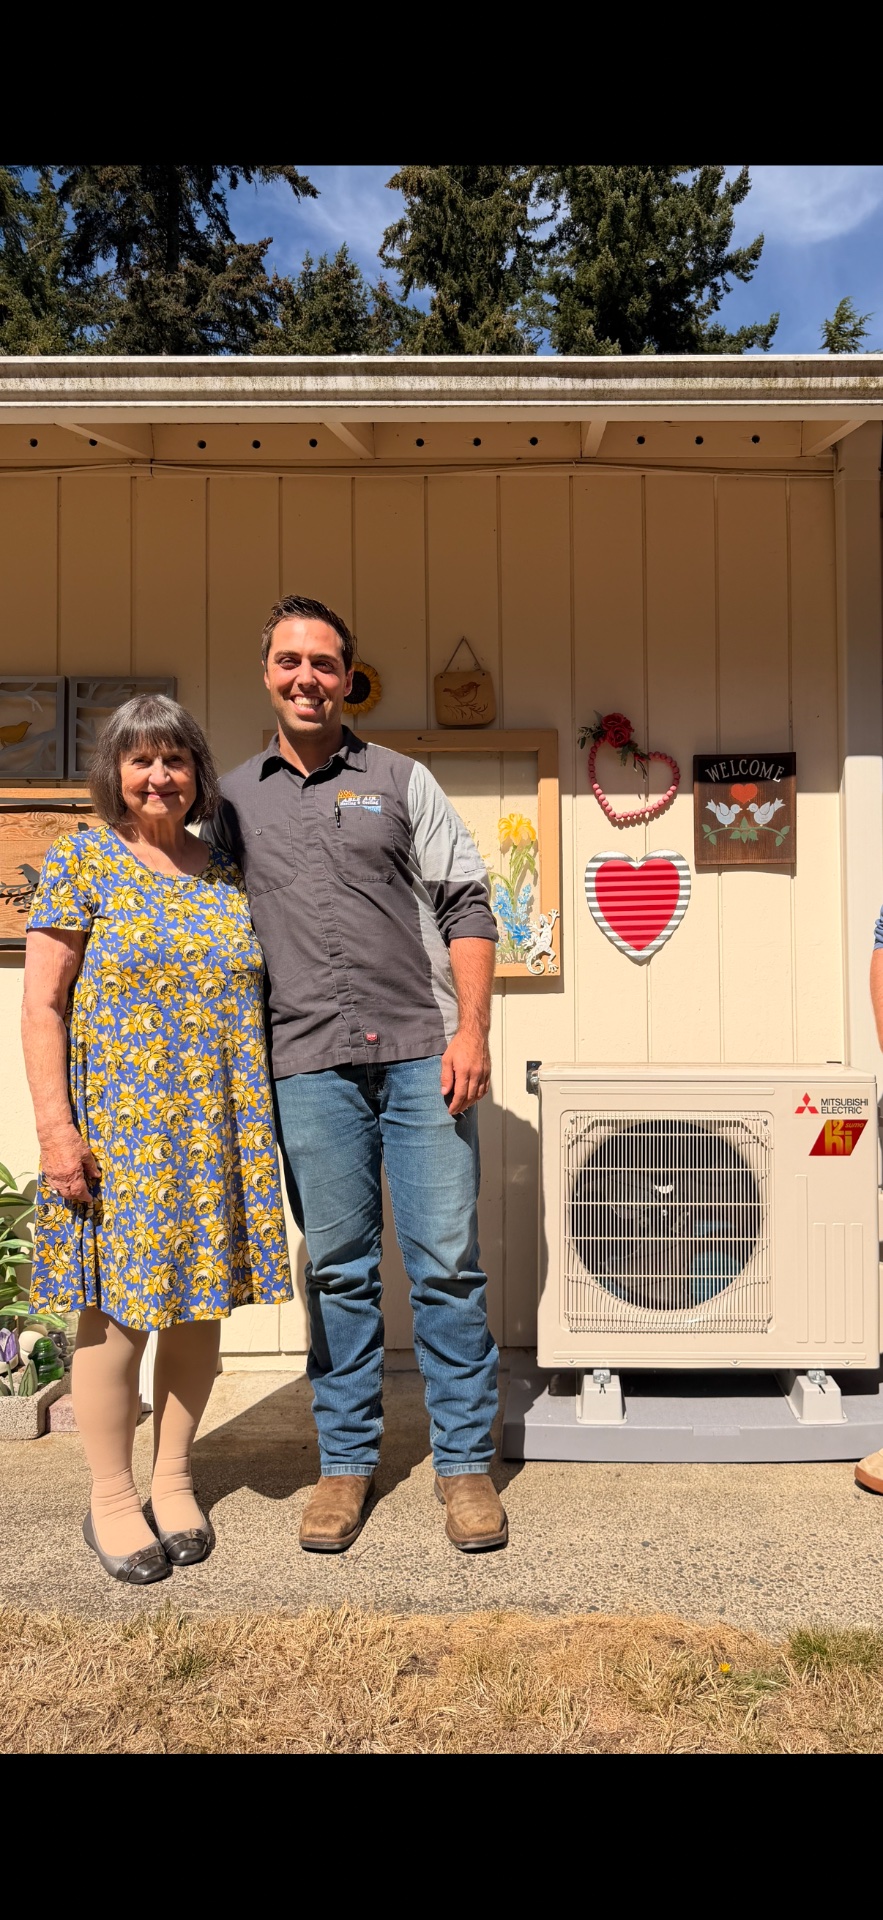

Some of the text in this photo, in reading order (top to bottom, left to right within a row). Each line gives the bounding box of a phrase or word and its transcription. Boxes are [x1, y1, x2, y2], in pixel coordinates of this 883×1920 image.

[705, 759, 785, 783] WELCOME
[821, 1098, 868, 1106] MITSUBISHI
[821, 1106, 862, 1114] ELECTRIC
